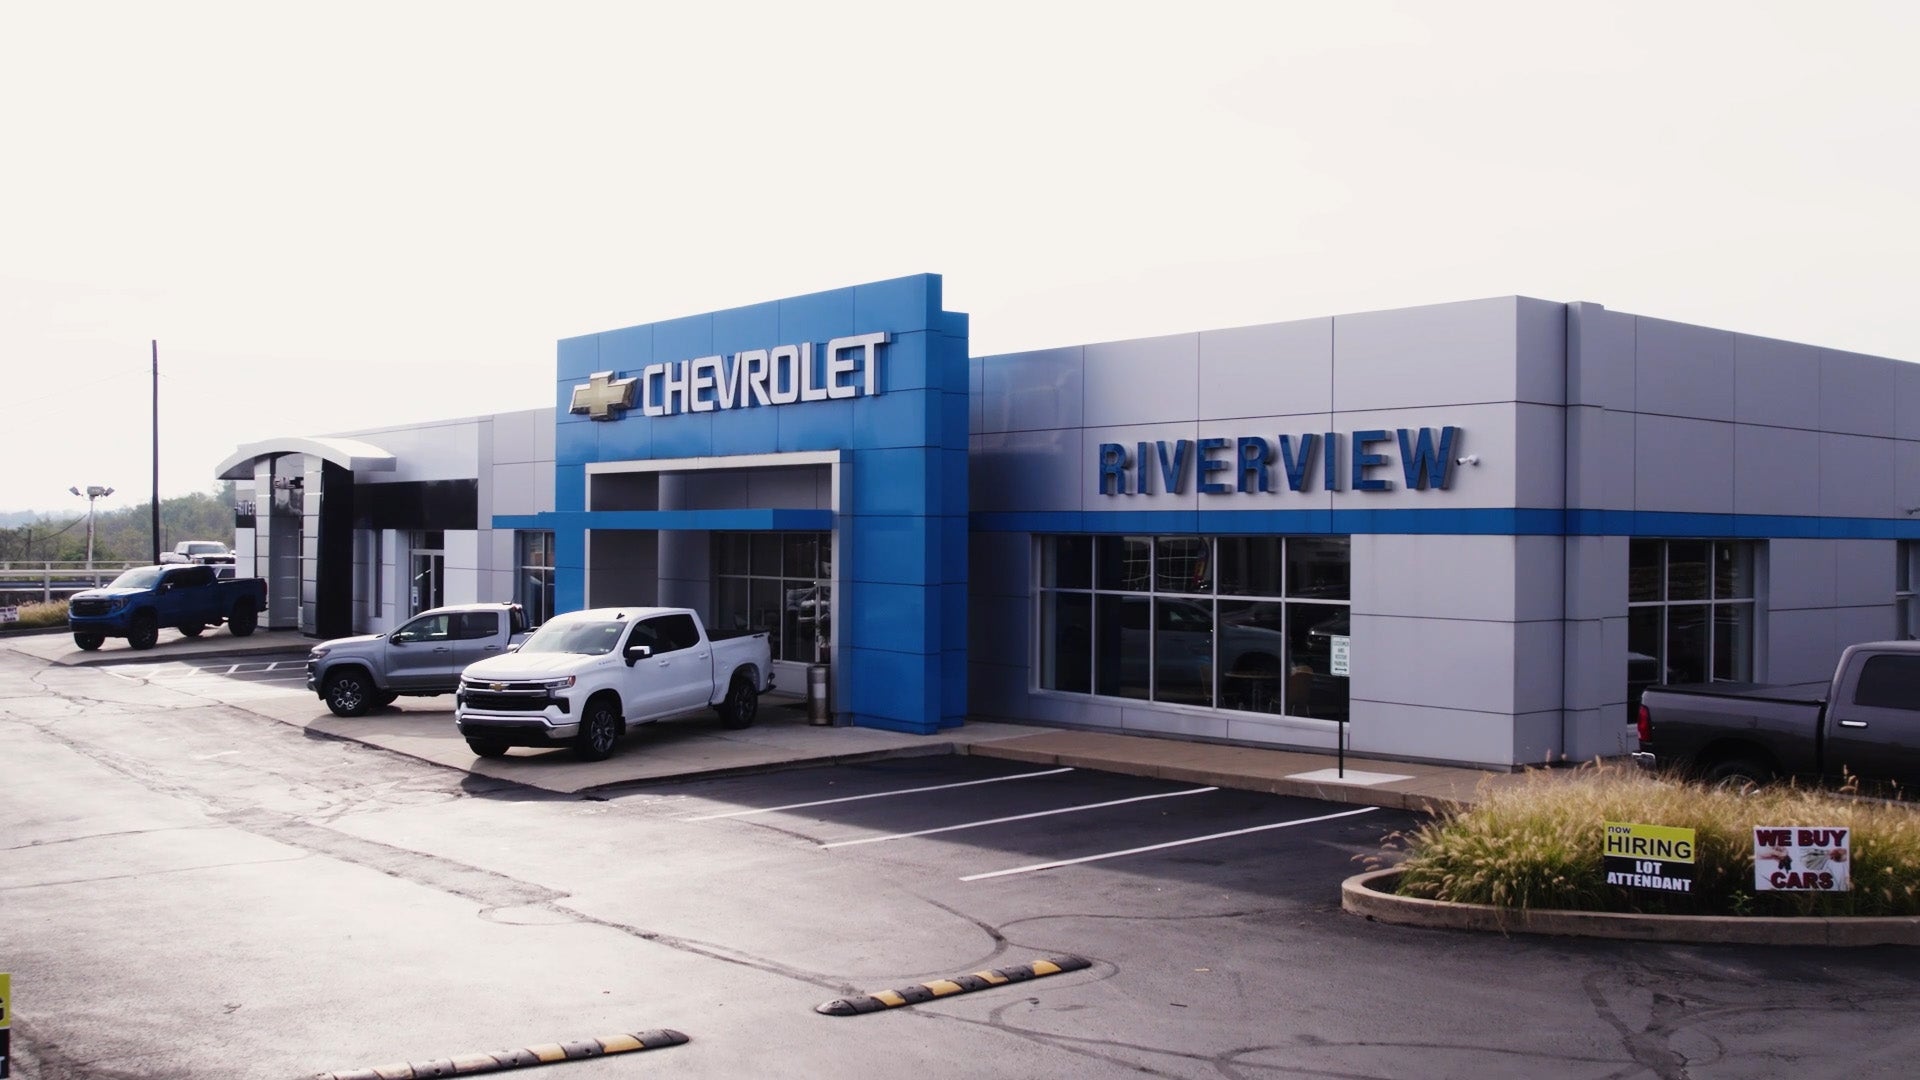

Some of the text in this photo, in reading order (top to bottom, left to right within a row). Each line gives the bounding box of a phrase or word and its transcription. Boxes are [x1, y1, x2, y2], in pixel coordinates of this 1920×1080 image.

[643, 331, 891, 417] CHEVROLET
[1099, 426, 1461, 496] RIVERVIEW
[1608, 826, 1631, 835] now
[1756, 830, 1847, 848] WE BUY
[1607, 835, 1691, 859] HIRING
[1635, 861, 1662, 875] LOT
[1607, 872, 1692, 892] ATTENDANT
[1770, 872, 1834, 889] CARS
